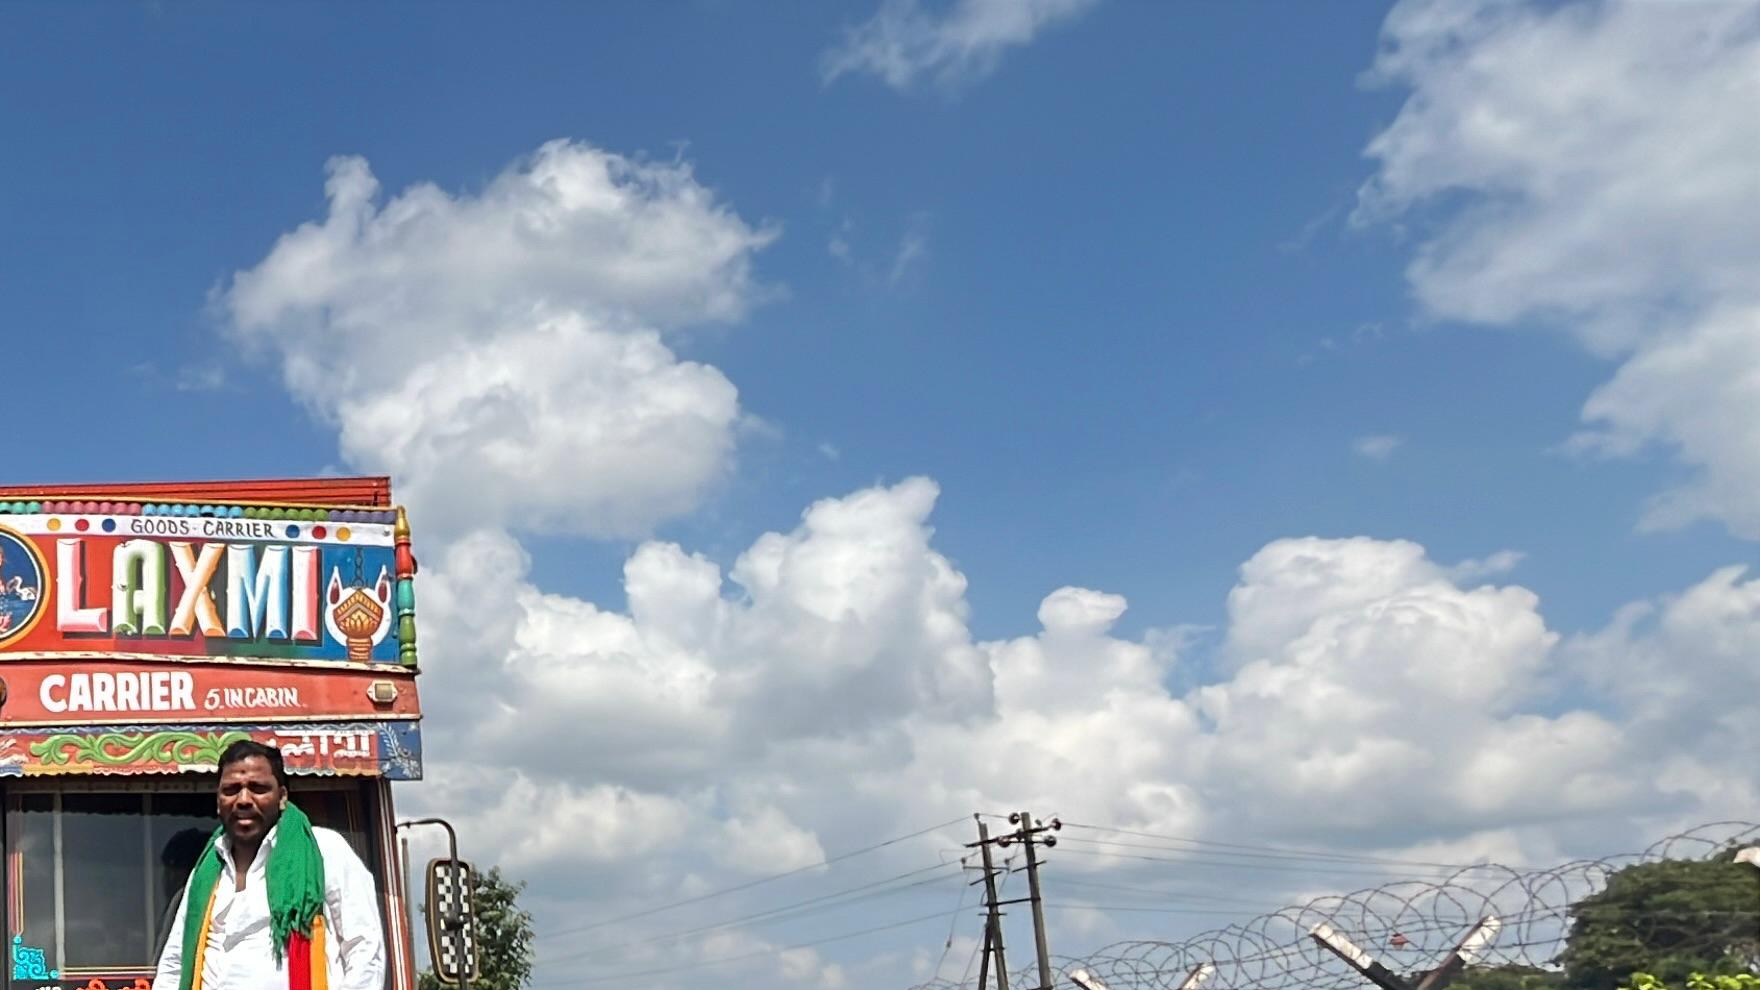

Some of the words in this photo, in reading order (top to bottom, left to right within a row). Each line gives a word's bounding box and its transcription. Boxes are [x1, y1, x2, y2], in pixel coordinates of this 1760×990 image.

[130, 518, 190, 535] GOODS
[202, 520, 276, 538] CARRIER
[56, 538, 321, 642] LAXMI
[40, 671, 197, 713] CARRIER
